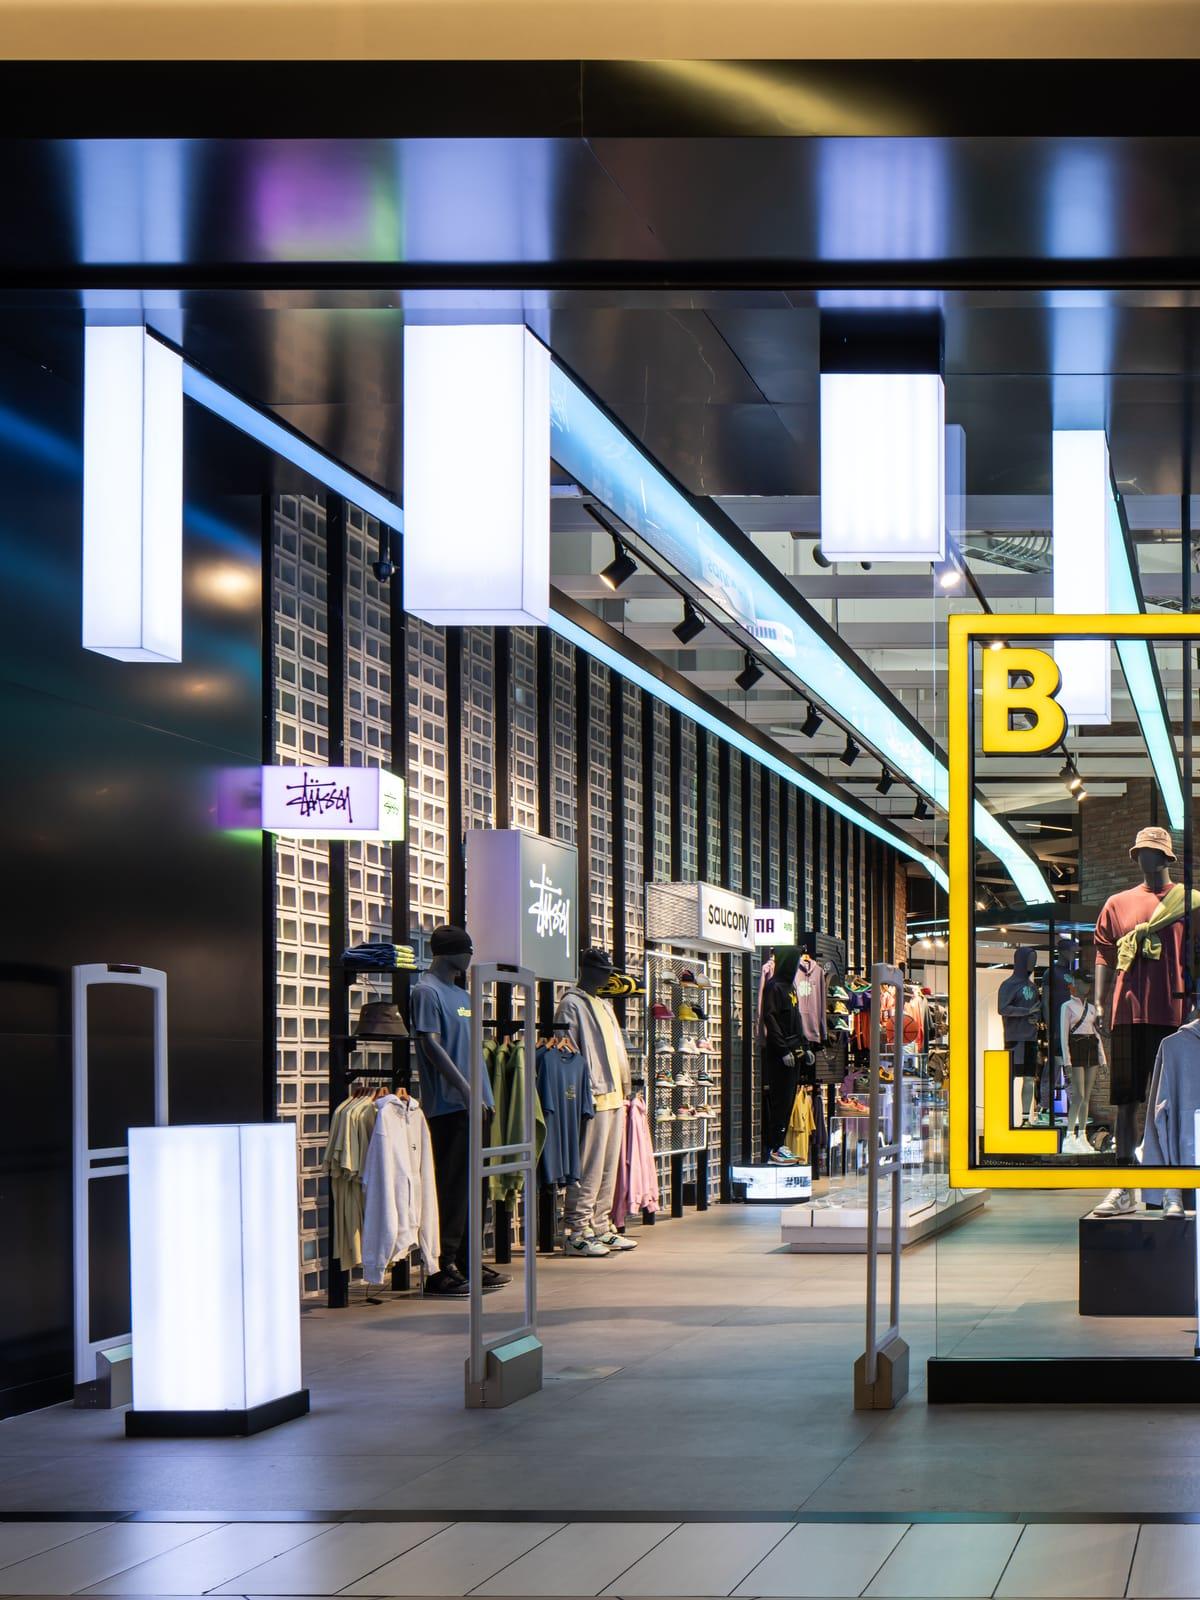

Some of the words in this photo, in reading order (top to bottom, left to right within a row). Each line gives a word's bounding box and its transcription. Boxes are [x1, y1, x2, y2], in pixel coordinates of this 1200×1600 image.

[982, 647, 1067, 754] B
[708, 904, 750, 937] saucony
[983, 1050, 1061, 1155] L
